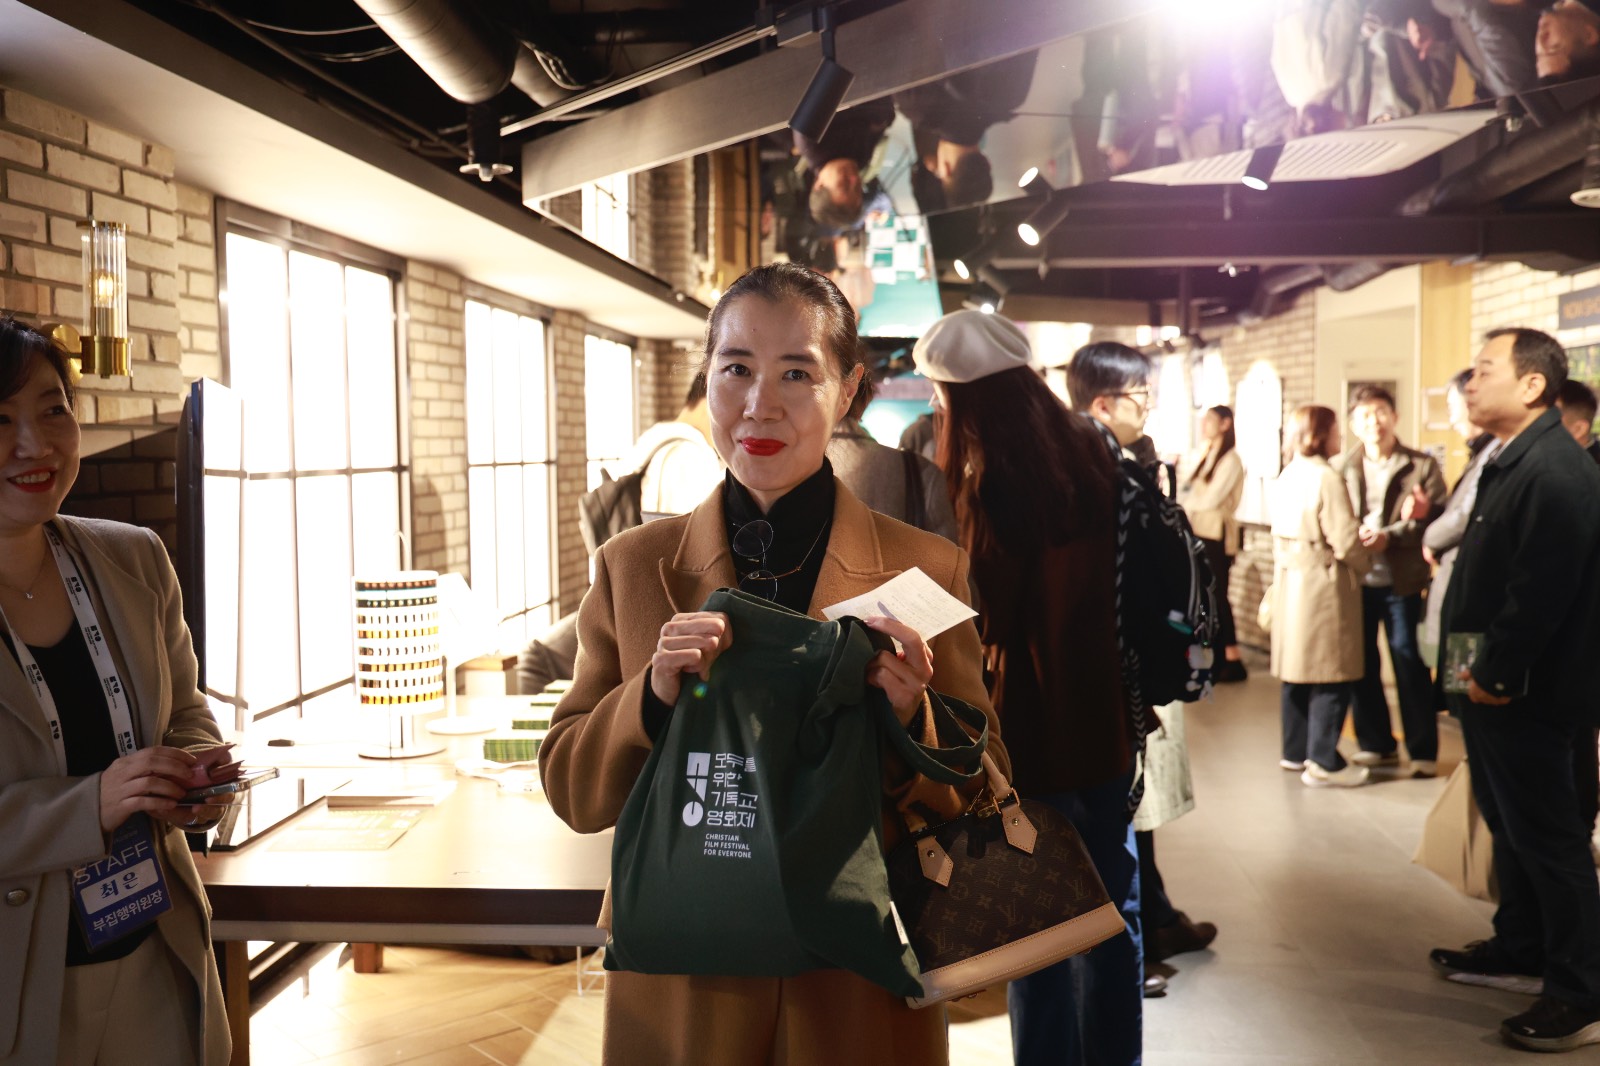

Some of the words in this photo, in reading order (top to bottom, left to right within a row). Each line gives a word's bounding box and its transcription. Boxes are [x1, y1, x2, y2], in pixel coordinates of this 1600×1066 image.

[714, 753, 757, 772] 모두를
[712, 772, 743, 788] 위한
[711, 791, 758, 809] 기독교
[707, 810, 756, 828] 영화제
[705, 833, 740, 842] CHRISTIAN
[720, 842, 750, 851] FESTIVAL
[73, 841, 149, 885] STAFF
[718, 850, 752, 859] EVERYONE
[93, 890, 163, 932] 부집행위원장
